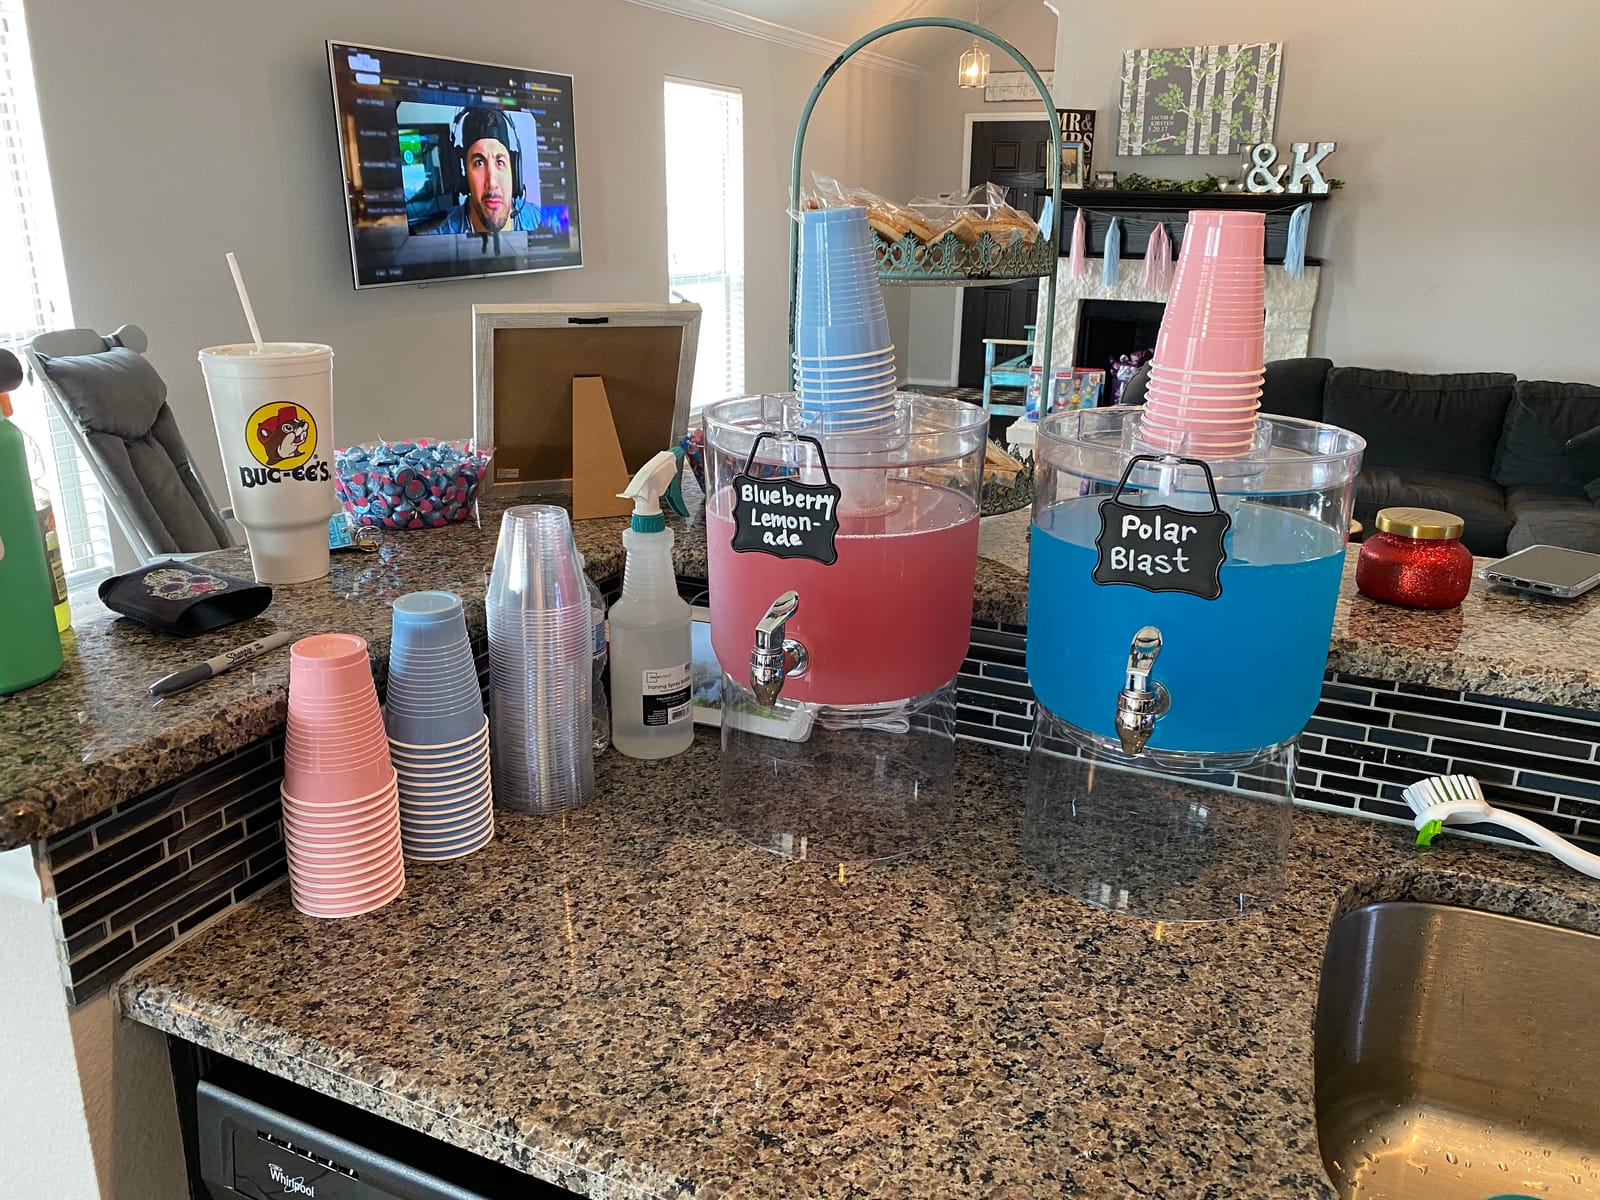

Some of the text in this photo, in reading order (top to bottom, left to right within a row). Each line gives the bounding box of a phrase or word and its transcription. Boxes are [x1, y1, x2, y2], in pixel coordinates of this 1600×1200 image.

[741, 484, 834, 521] Blueberry
[751, 507, 821, 532] Lemon-
[1121, 514, 1198, 544] Polar
[762, 528, 803, 548] ade
[1110, 546, 1190, 576] Blast
[226, 647, 256, 664] Sharpie
[269, 1163, 315, 1198] Whirlpool
